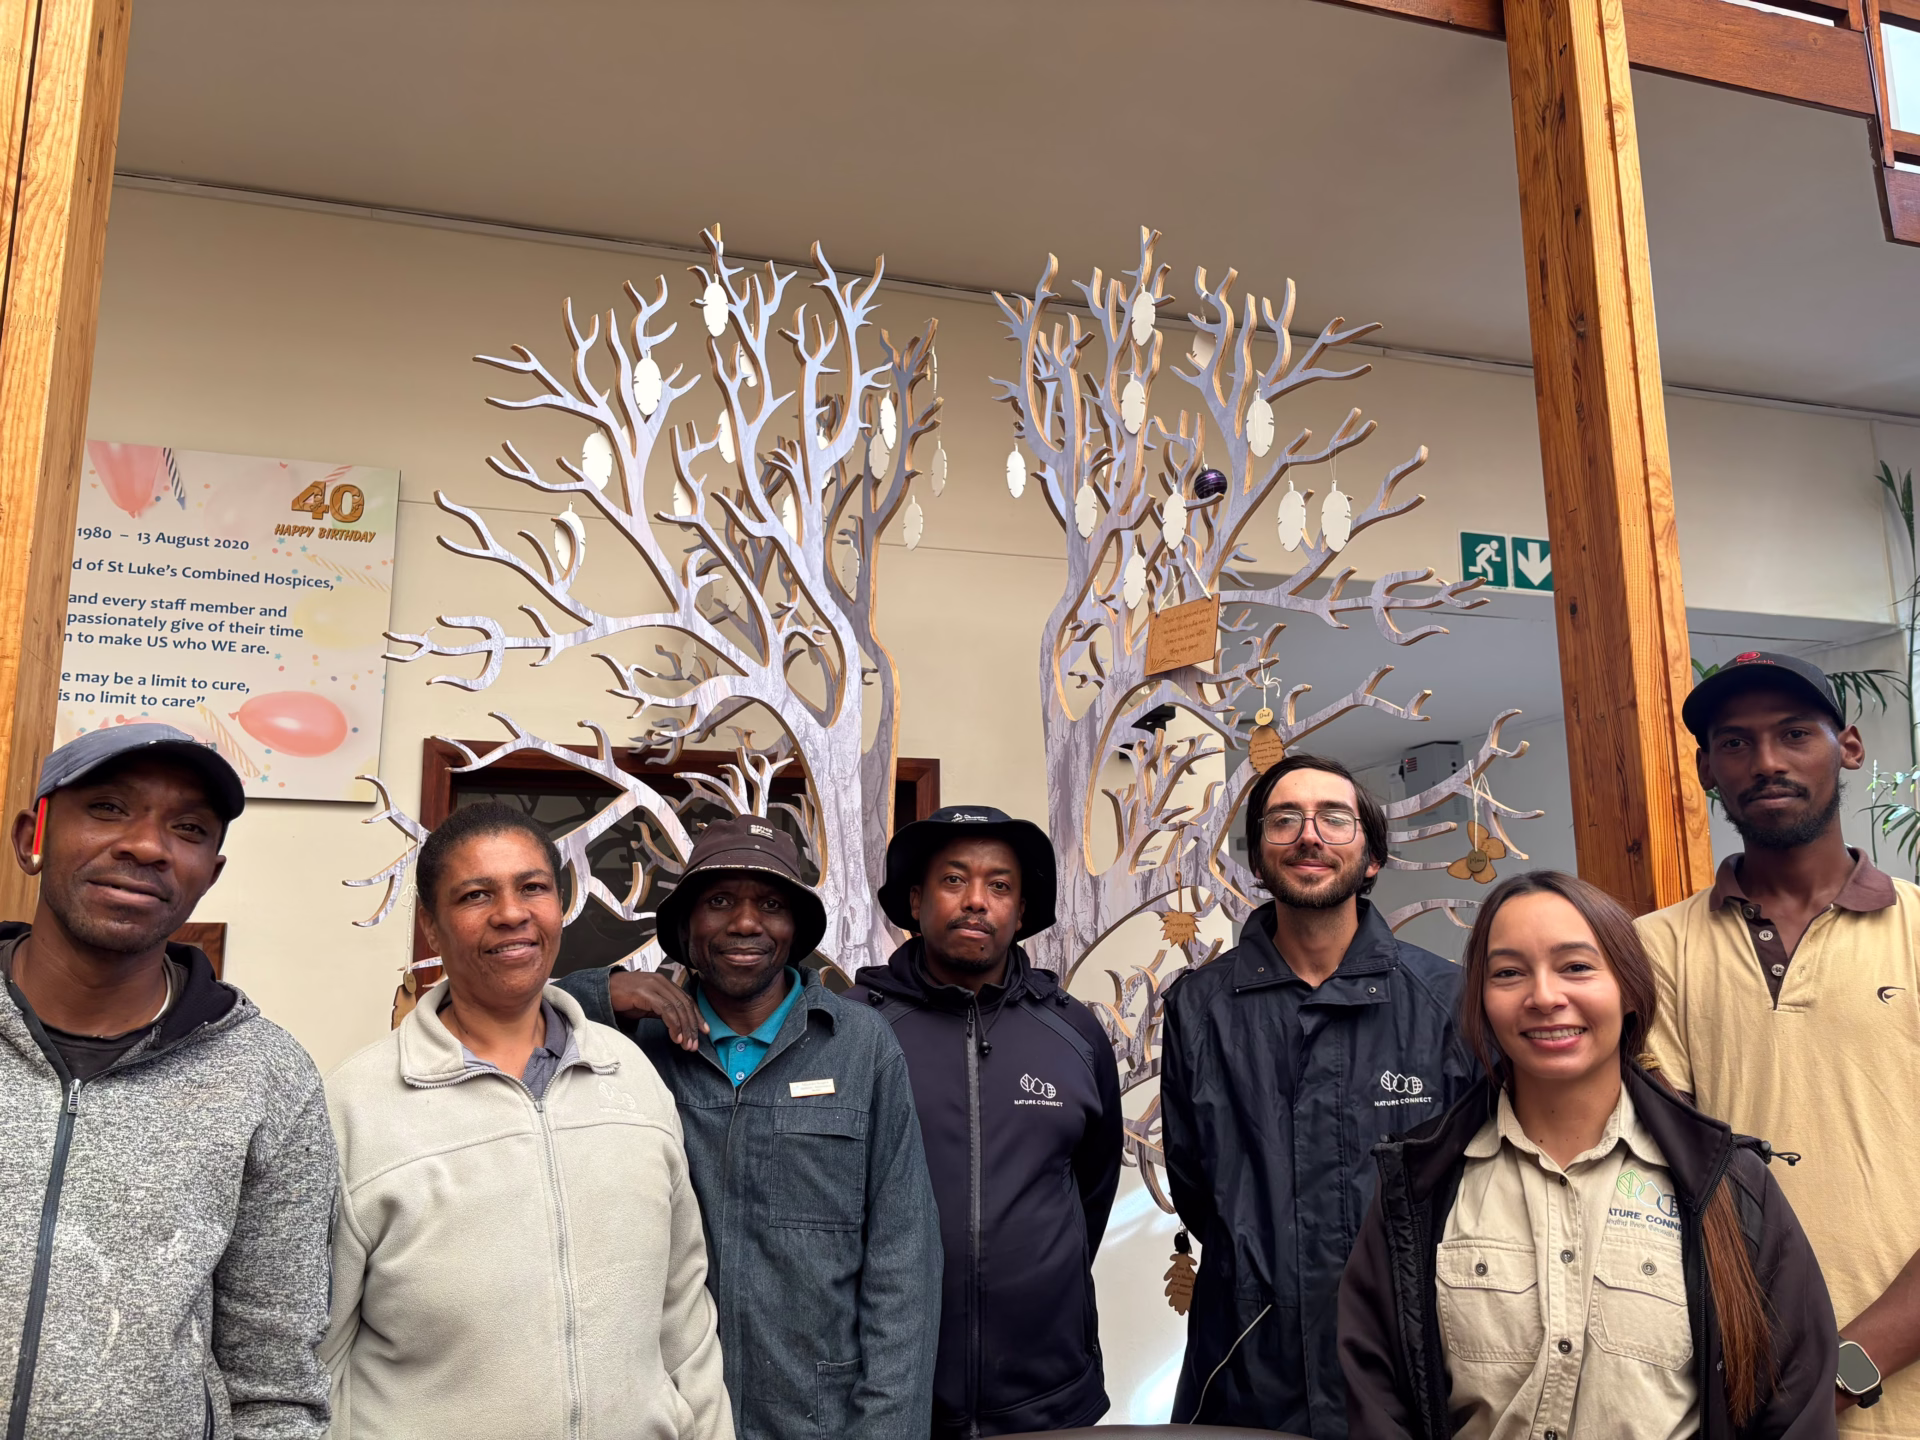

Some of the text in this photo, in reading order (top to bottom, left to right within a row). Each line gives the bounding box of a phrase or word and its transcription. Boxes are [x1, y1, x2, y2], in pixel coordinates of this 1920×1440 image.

[291, 480, 365, 523] 40
[76, 526, 112, 540] 1980
[137, 532, 151, 545] 13
[154, 532, 210, 549] August
[213, 538, 250, 551] 2020
[274, 523, 376, 543] HAPPY BIRTHDAY
[86, 559, 104, 571] of
[107, 561, 124, 573] St
[181, 566, 260, 583] Combined
[264, 572, 335, 592] Hospices,
[68, 592, 288, 618] and every staff member and
[170, 618, 204, 633] give
[208, 621, 226, 632] of
[229, 622, 266, 636] their
[269, 624, 304, 638] time
[77, 632, 95, 644] to
[98, 633, 143, 647] make
[147, 636, 169, 648] US
[172, 637, 207, 651] who
[211, 639, 238, 653] WE
[240, 643, 270, 655] are.
[75, 673, 110, 687] may
[113, 672, 134, 685] be
[137, 676, 147, 686] a
[151, 674, 188, 689] limit
[191, 678, 208, 690] to
[211, 680, 251, 695] cure,
[74, 692, 96, 703] no
[100, 691, 137, 705] limit
[141, 694, 158, 706] to
